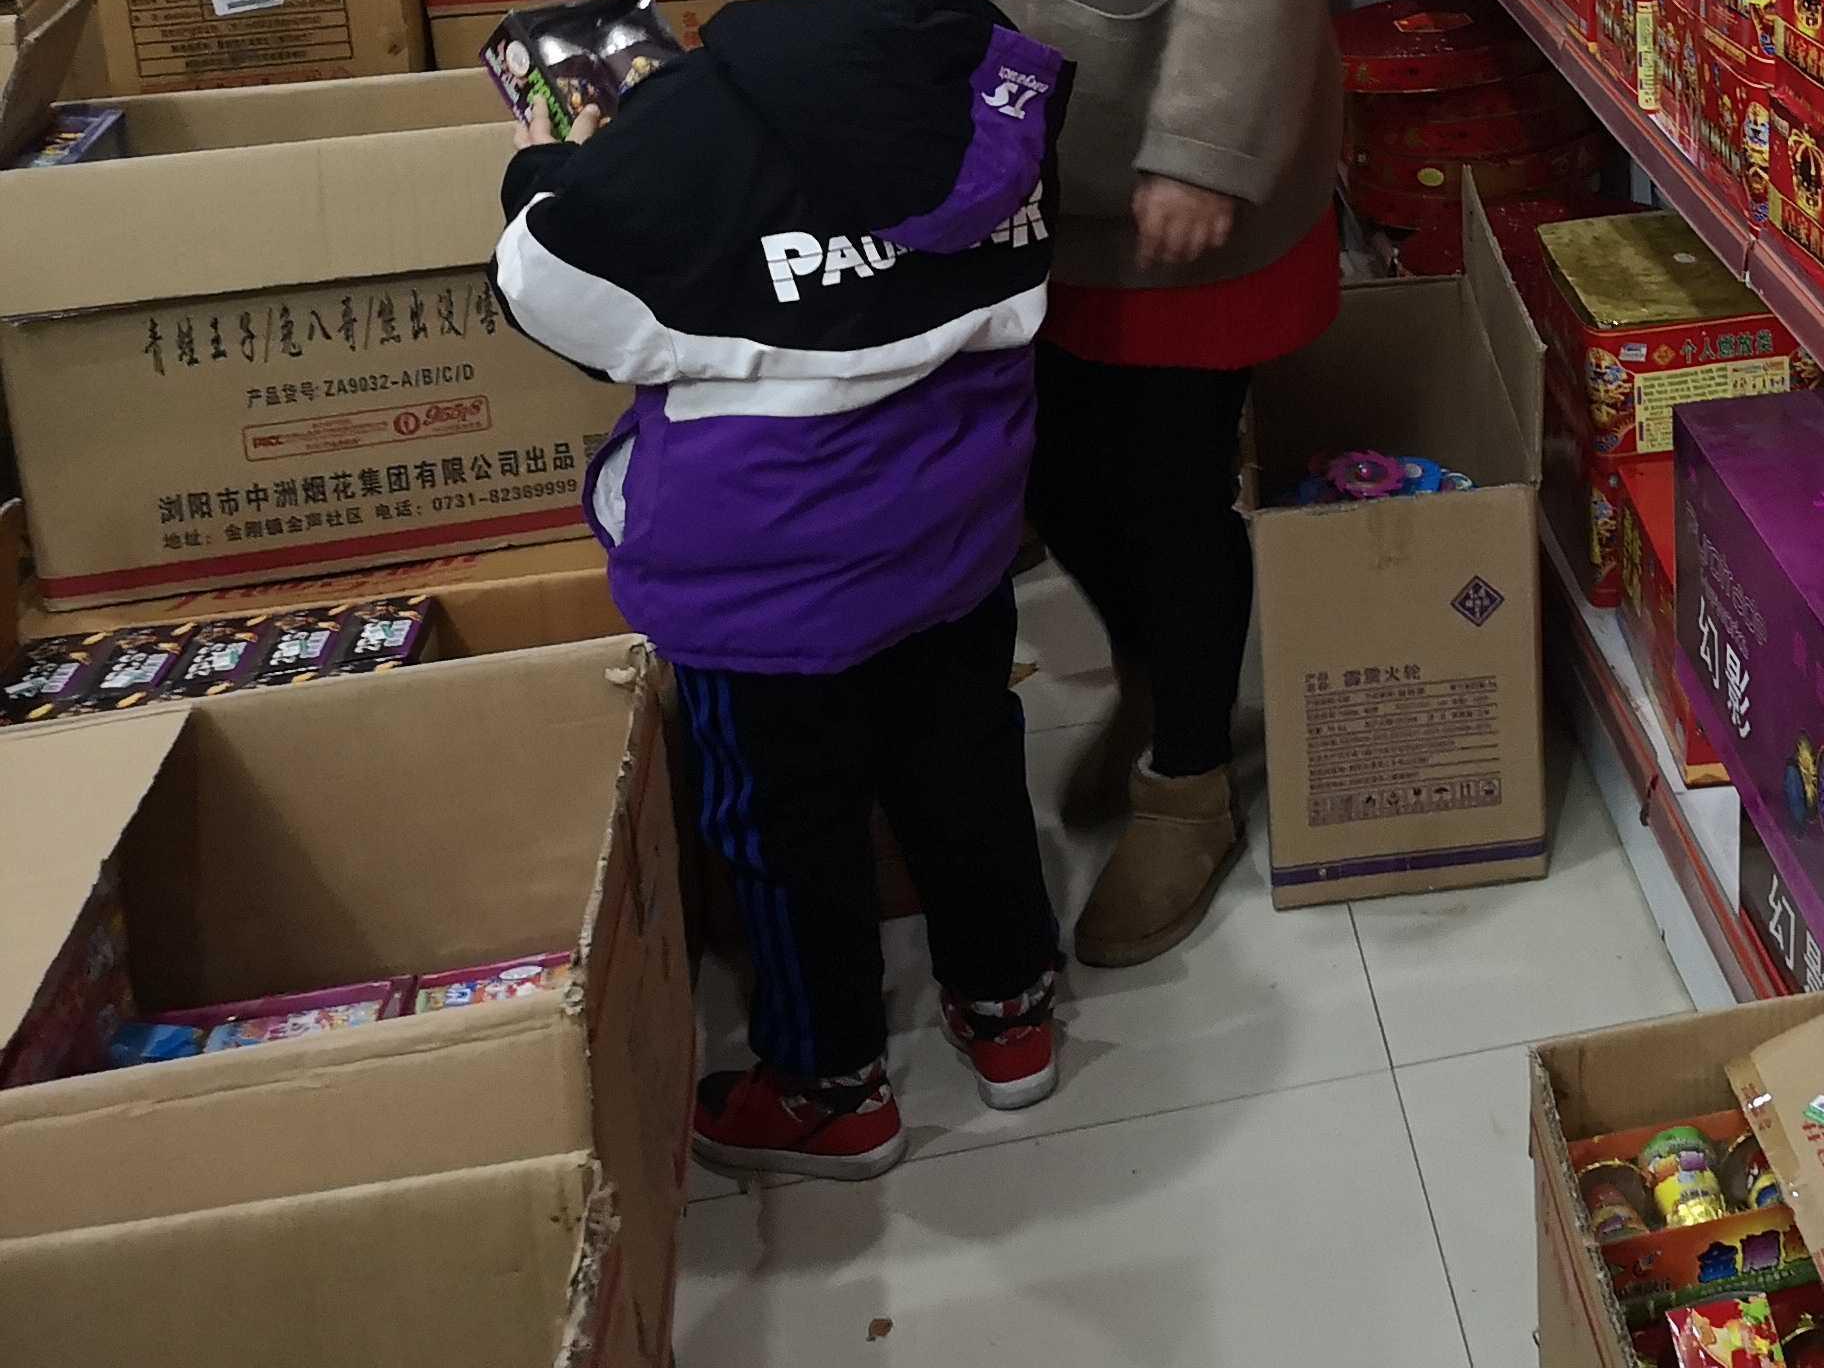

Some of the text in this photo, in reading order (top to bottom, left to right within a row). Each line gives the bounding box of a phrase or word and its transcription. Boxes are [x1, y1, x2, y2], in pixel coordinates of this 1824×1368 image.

[1679, 329, 1774, 365] 个人燃放类
[158, 441, 576, 526] 浏阳市中洲烟花集团有限公司出品
[1697, 595, 1752, 739] 幻影
